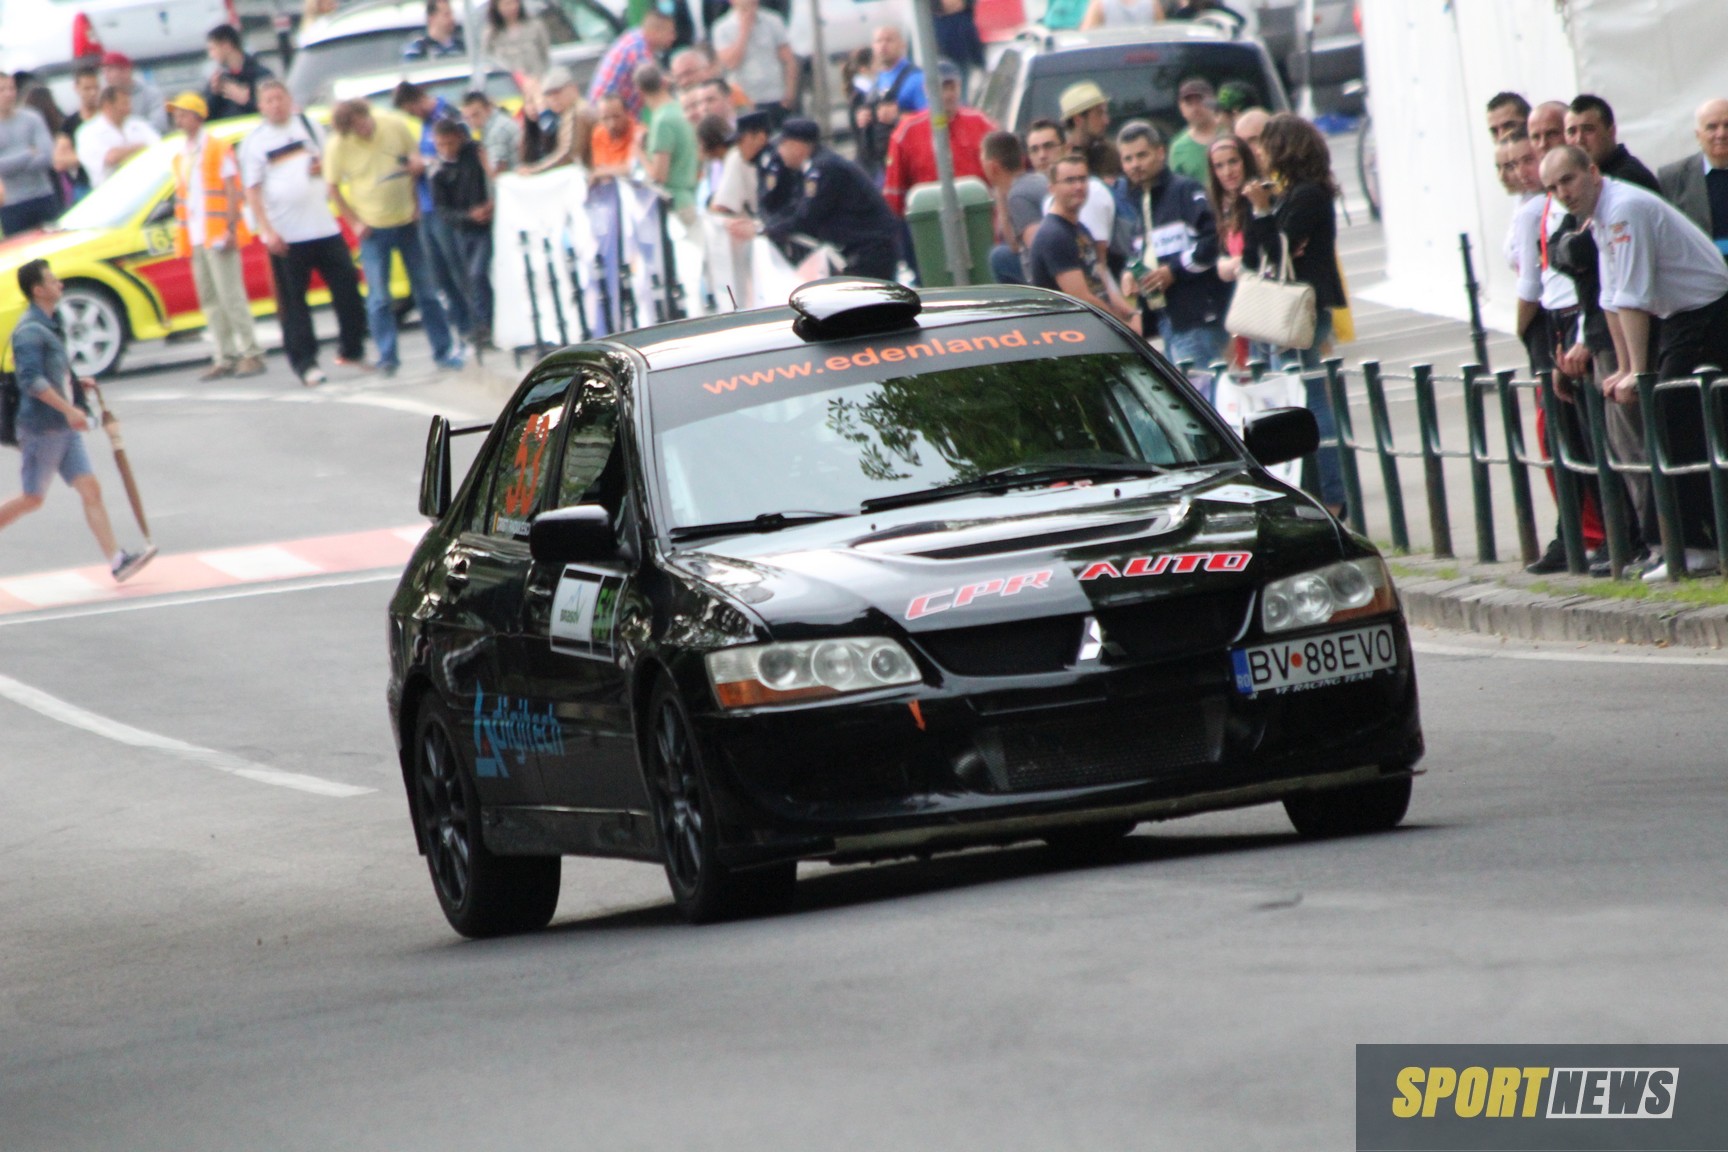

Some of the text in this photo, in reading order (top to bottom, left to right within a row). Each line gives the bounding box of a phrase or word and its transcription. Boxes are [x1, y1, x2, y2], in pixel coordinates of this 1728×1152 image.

[702, 328, 1086, 395] www.edenland.ro
[904, 552, 1253, 620] CPR AUTO
[1235, 673, 1250, 689] RO
[492, 694, 565, 766] digitech
